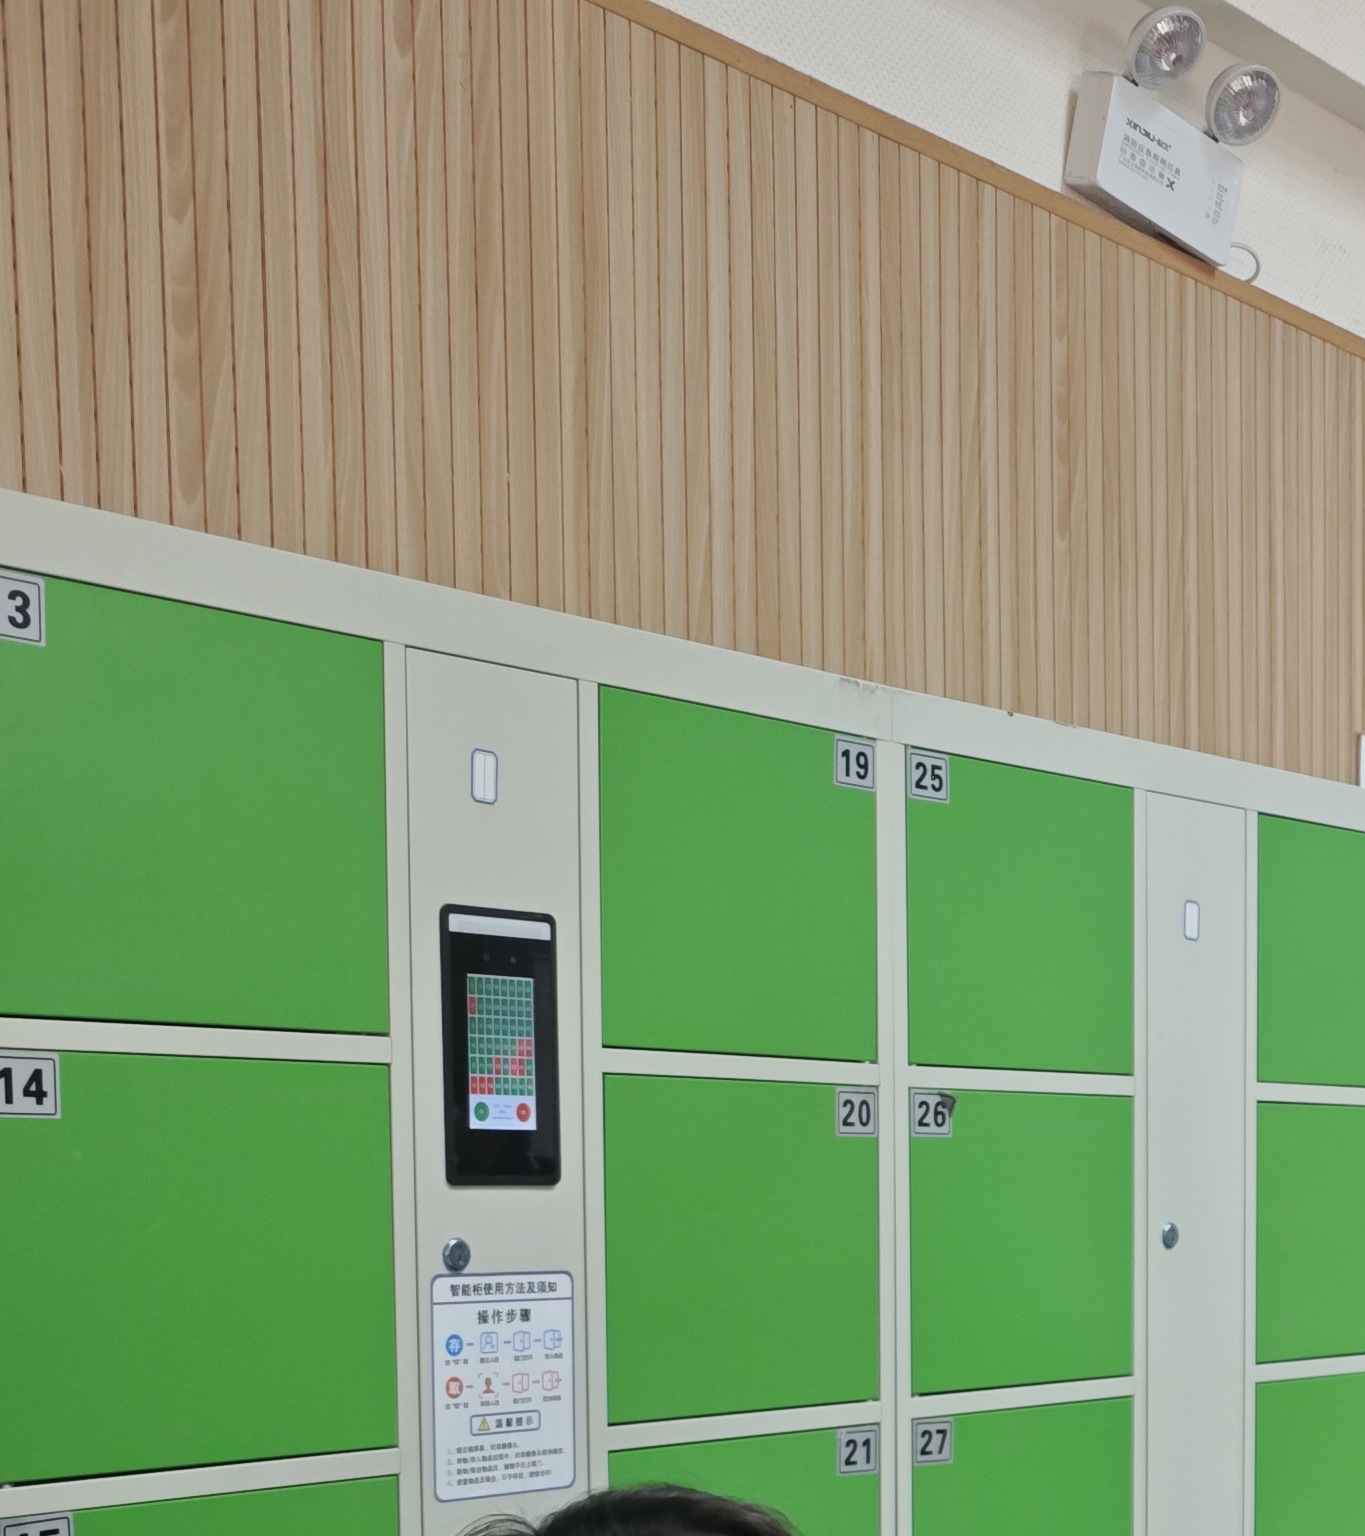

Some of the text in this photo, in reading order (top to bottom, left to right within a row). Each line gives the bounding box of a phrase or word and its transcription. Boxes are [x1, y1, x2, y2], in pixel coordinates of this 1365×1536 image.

[841, 749, 869, 780] 19
[914, 762, 944, 792] 25
[0, 1067, 47, 1105] 14
[842, 1100, 871, 1128] 20
[915, 1101, 947, 1128] 26
[450, 1281, 558, 1297] 智能柜使用方法及须知
[477, 1308, 531, 1325] 操作步骤
[844, 1439, 872, 1466] 21
[919, 1430, 948, 1456] 27
